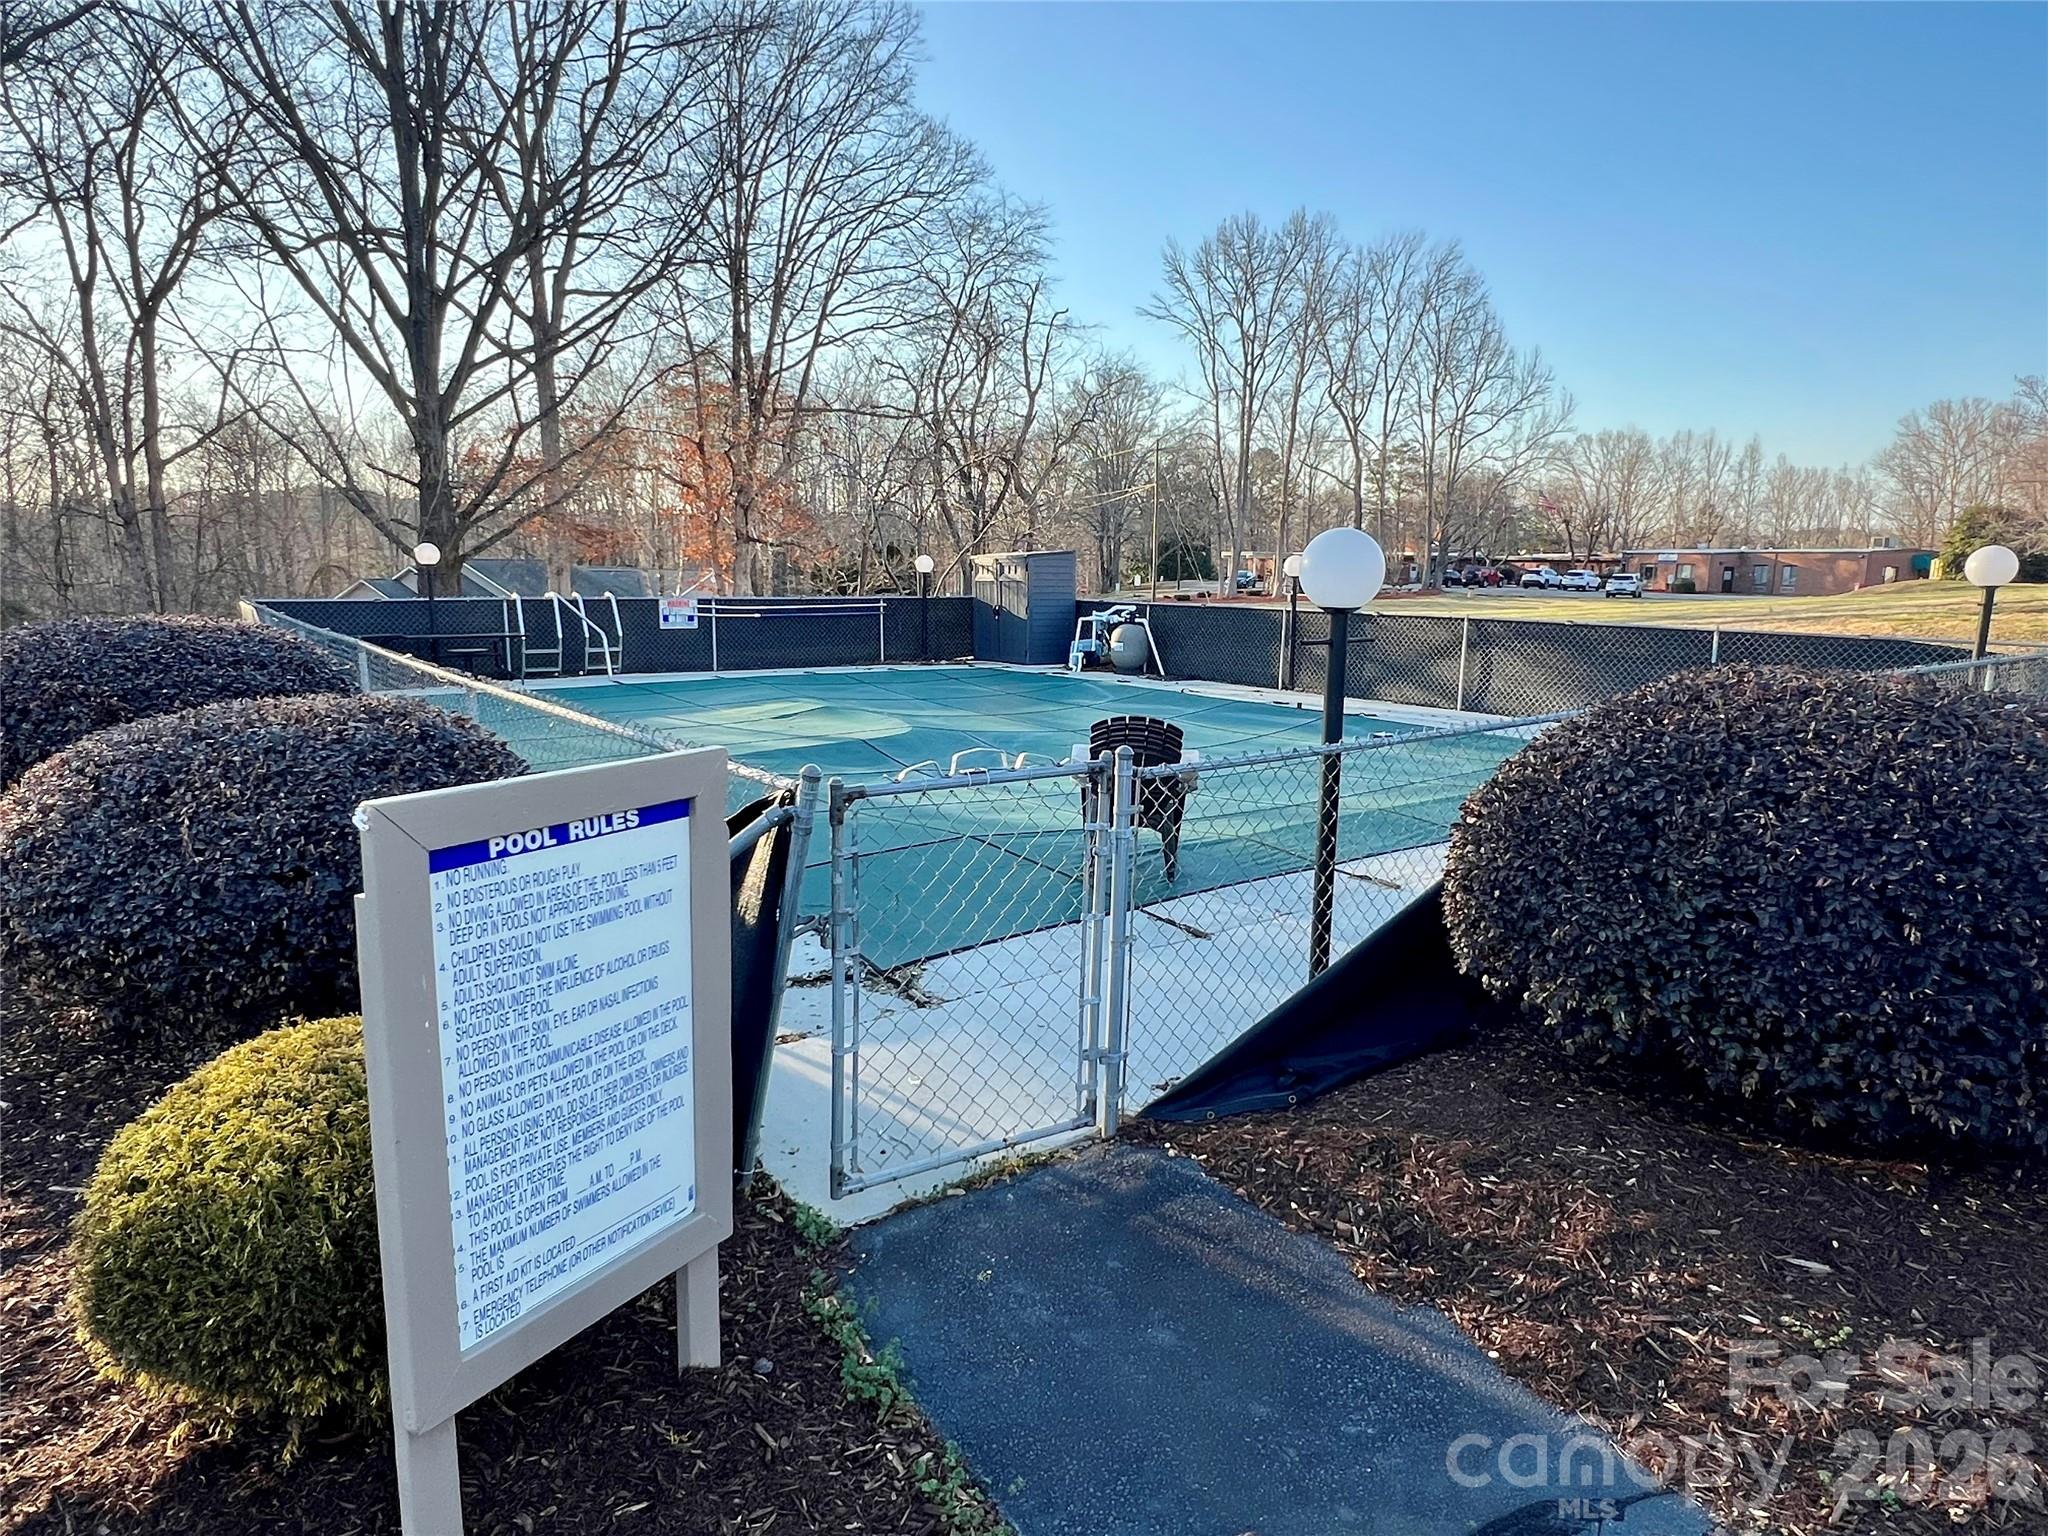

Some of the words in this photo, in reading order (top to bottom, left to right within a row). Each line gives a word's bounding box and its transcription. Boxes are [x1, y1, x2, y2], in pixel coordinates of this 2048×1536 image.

[488, 825, 557, 859] POOL
[568, 809, 639, 841] RULES
[445, 868, 460, 888] NO
[446, 890, 461, 909] NO
[462, 876, 517, 906] BOISTEROUS
[519, 873, 530, 891] OR
[532, 866, 561, 888] ROUGH
[447, 910, 462, 929] NO
[463, 902, 494, 925] DIVING
[495, 891, 535, 917] ALLOWED
[536, 889, 544, 906] IN
[546, 882, 571, 903] AREAS
[572, 879, 583, 896] OF
[583, 875, 598, 893] THE
[449, 924, 473, 947] DEEP
[474, 920, 489, 940] OR
[489, 918, 499, 936] IN
[501, 910, 528, 933] POOLS
[530, 905, 546, 925] NOT
[548, 894, 587, 920] APPROVED
[450, 940, 496, 969] CHILDREN
[498, 929, 534, 955] SHOULD
[534, 924, 551, 945] NOT
[552, 919, 569, 940] USE
[570, 914, 585, 934] THE
[586, 902, 623, 929] SWIMMING
[451, 963, 482, 988] ADULT
[453, 981, 484, 1007] ADULTS
[485, 971, 517, 997] SHOULD
[518, 966, 534, 986] NOT
[535, 959, 555, 981] SWIM
[453, 1007, 468, 1027] NO
[469, 995, 505, 1022] PERSON
[506, 985, 535, 1009] UNDER
[536, 979, 552, 1000] THE
[554, 965, 594, 994] INFLUENCE
[454, 1016, 491, 1044] SHOULD
[492, 1010, 510, 1031] USE
[511, 1004, 528, 1025] THE
[455, 1043, 470, 1064] NO
[471, 1030, 507, 1059] PERSON
[508, 1022, 530, 1045] WITH
[571, 1002, 586, 1022] EAR
[587, 997, 598, 1016] OR
[457, 1050, 500, 1080] ALLOWED
[501, 1046, 510, 1064] IN
[511, 1040, 528, 1061] THE
[458, 1079, 472, 1100] NO
[473, 1064, 513, 1094] PERSONS
[514, 1056, 535, 1079] WITH
[536, 1033, 593, 1070] COMMUNICABLE
[460, 1100, 474, 1121] NO
[475, 1085, 512, 1115] ANIMALS
[513, 1079, 526, 1099] OR
[527, 1071, 548, 1094] PETS
[549, 1055, 585, 1085] ALLOWED
[585, 1052, 593, 1069] IN
[460, 1119, 475, 1140] NO
[476, 1107, 505, 1134] GLASS
[506, 1091, 545, 1121] ALLOWED
[545, 1087, 554, 1105] IN
[555, 1080, 570, 1101] THE
[571, 1070, 591, 1093] POOL
[591, 1066, 602, 1085] OR
[462, 1139, 478, 1160] ALL
[479, 1121, 519, 1153] PERSONS
[519, 1111, 544, 1136] USING
[545, 1101, 565, 1125] POOL
[566, 1096, 578, 1115] DO
[578, 1091, 588, 1110] SO
[589, 1087, 598, 1104] AT
[463, 1137, 521, 1177] MANAGEMENT
[522, 1129, 539, 1151] ARE
[540, 1122, 556, 1143] NOT
[557, 1099, 603, 1135] RESPONSIBLE
[464, 1170, 489, 1196] POOL
[490, 1166, 499, 1184] IS
[500, 1157, 517, 1180] FOR
[518, 1142, 552, 1171] PRIVATE
[571, 1116, 605, 1147] MEMBERS
[465, 1173, 525, 1215] MANAGEMENT
[526, 1153, 567, 1186] RESERVES
[567, 1146, 582, 1166] THE
[583, 1135, 604, 1159] RIGHT
[467, 1210, 481, 1231] TO
[481, 1193, 516, 1224] ANYONE
[518, 1187, 528, 1206] AT
[529, 1178, 546, 1201] ANY
[468, 1225, 489, 1250] THIS
[490, 1213, 513, 1239] POOL
[514, 1208, 523, 1226] IS
[523, 1197, 546, 1222] OPEN
[546, 1186, 568, 1210] FROM
[588, 1167, 603, 1188] A.M.
[469, 1245, 487, 1269] THE
[488, 1225, 527, 1259] MAXIMUM
[528, 1208, 560, 1238] NUMBER
[561, 1202, 572, 1221] OF
[572, 1181, 610, 1215] SWIMMERS
[470, 1258, 495, 1285] POOL
[495, 1253, 505, 1272] IS
[471, 1287, 479, 1305] A
[480, 1273, 504, 1300] FIRST
[505, 1265, 519, 1286] AID
[520, 1258, 532, 1278] KIT
[533, 1253, 541, 1270] IS
[542, 1233, 576, 1266] LOCATED
[473, 1283, 524, 1326] EMERGENCY
[525, 1258, 567, 1296] TELEPHONE
[568, 1249, 582, 1270] (OR
[582, 1235, 606, 1261] OTHER
[474, 1322, 483, 1341] IS
[484, 1300, 522, 1335] LOCATED
